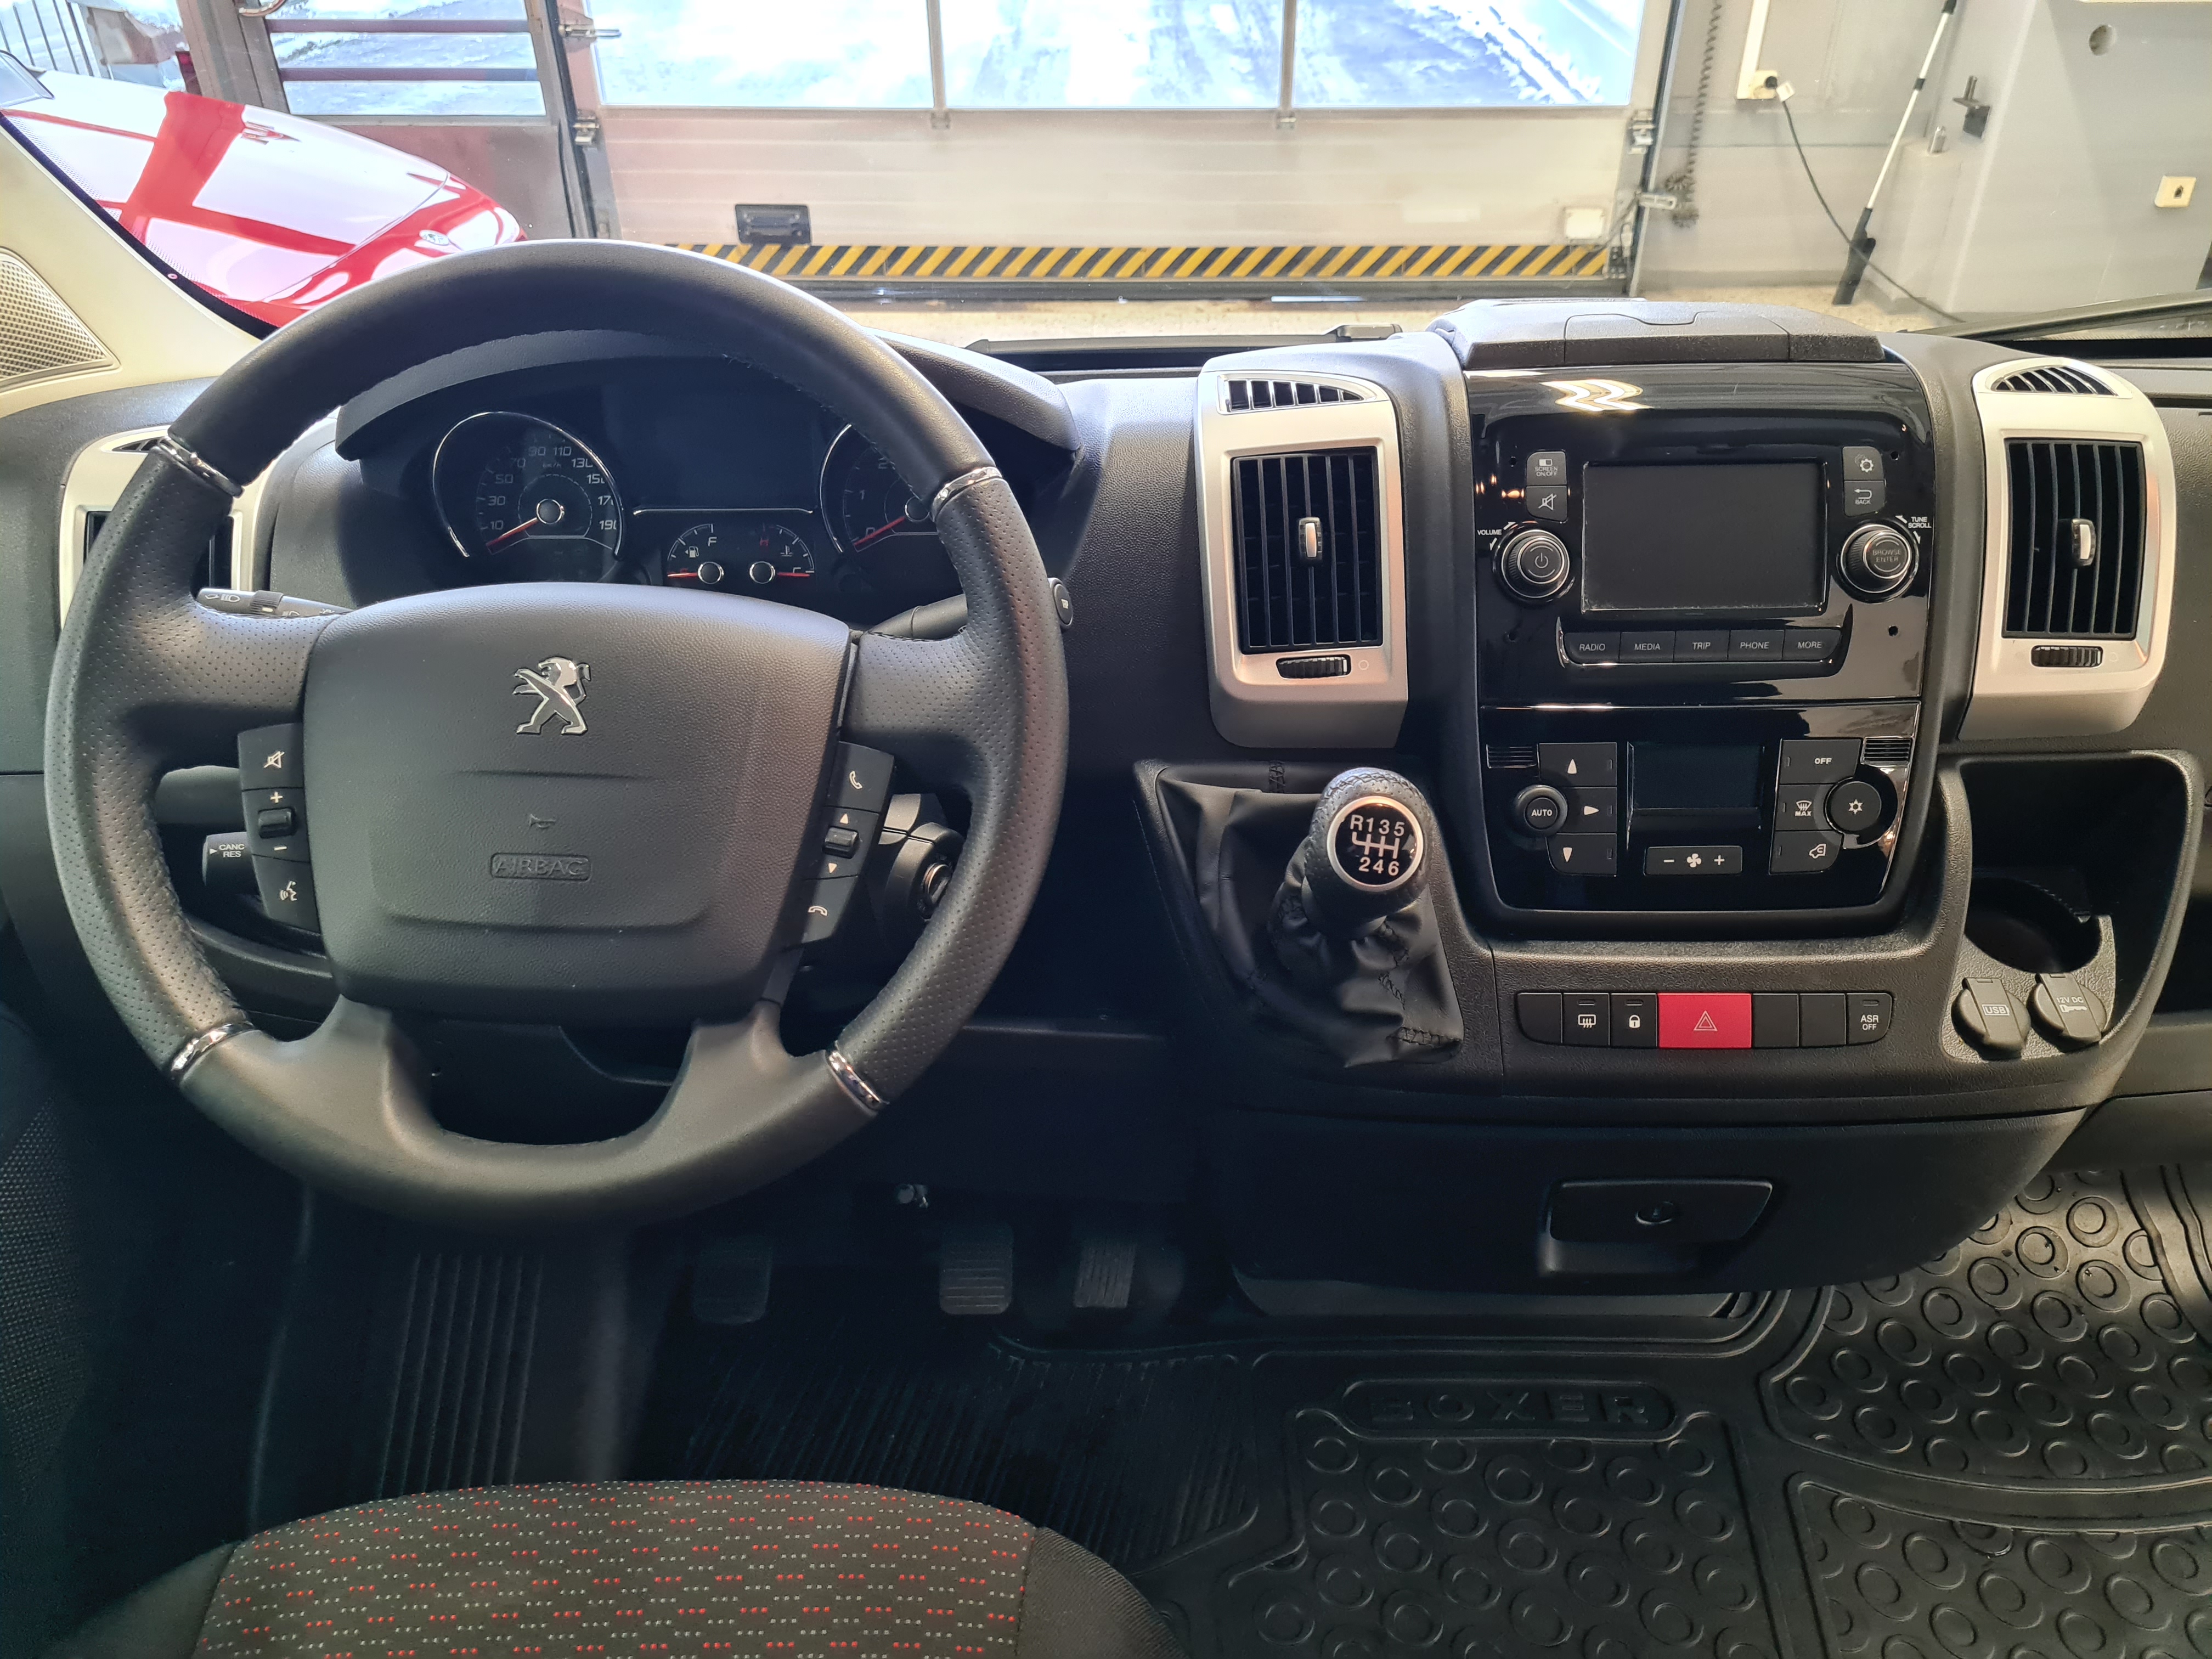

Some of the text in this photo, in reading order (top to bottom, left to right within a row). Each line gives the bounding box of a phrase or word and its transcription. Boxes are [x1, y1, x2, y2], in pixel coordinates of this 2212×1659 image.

[528, 446, 546, 457] 90
[553, 447, 572, 456] 110
[495, 474, 514, 484] 50
[487, 495, 506, 506] 30
[597, 495, 614, 505] 17
[490, 520, 504, 531] 10
[708, 537, 717, 546] F
[1692, 642, 1711, 650] TRIP
[494, 858, 586, 877] AIRBAG
[1984, 1006, 2006, 1014] USB
[1860, 1014, 1879, 1023] ASR
[1366, 1391, 1649, 1424] BOXER
